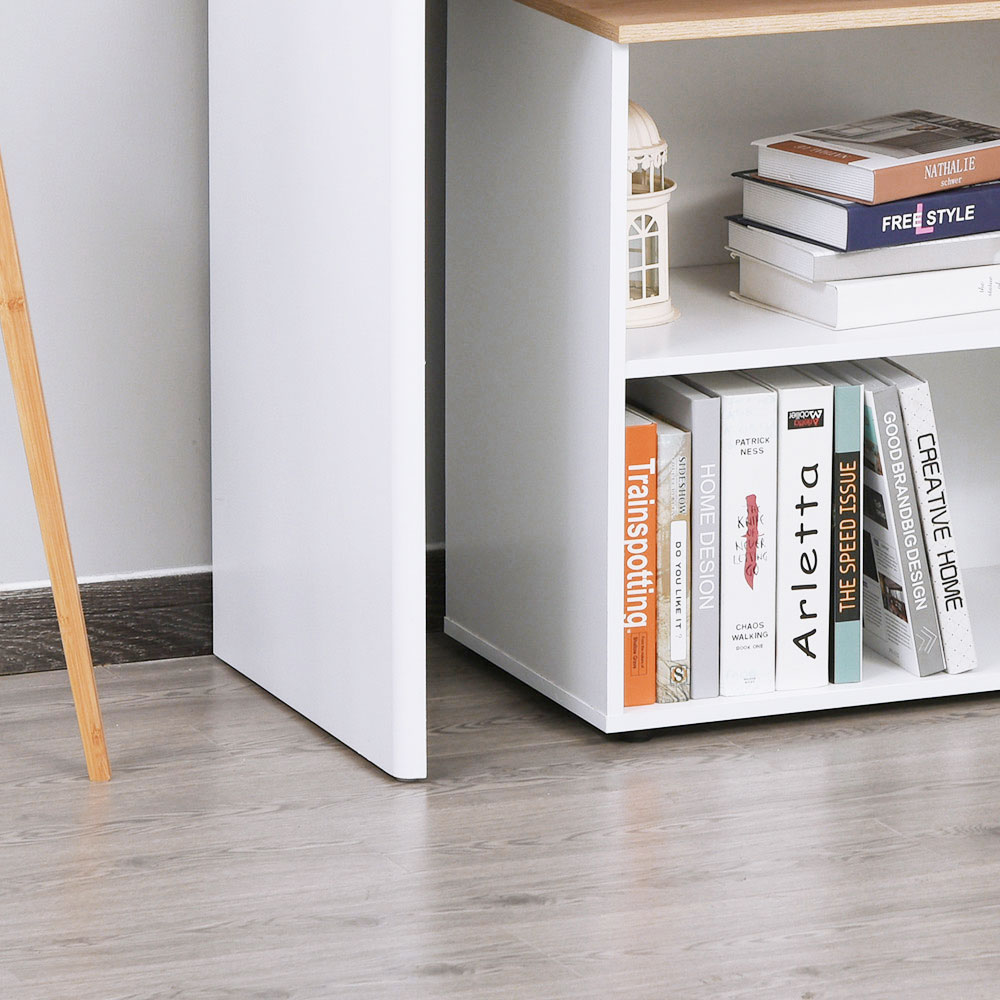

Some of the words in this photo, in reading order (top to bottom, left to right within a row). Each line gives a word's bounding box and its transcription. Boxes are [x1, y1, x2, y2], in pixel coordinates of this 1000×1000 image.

[924, 155, 976, 180] NATHALIE
[882, 211, 923, 232] FREE
[926, 205, 976, 226] STYLE
[735, 437, 770, 446] PATRICK
[740, 447, 764, 456] NESS
[678, 456, 686, 514] SIDESHOW
[700, 464, 716, 526] HOME
[839, 460, 857, 515] ISSUE
[917, 433, 952, 542] CREATIVE
[937, 549, 963, 612] HOME
[675, 541, 681, 558] DO
[791, 463, 819, 660] Arletta
[839, 518, 857, 574] SPEED
[699, 531, 715, 610] DESIGN
[839, 578, 856, 613] THE
[675, 619, 682, 629] IT
[731, 631, 769, 641] WALKING
[735, 621, 765, 631] CHAOS
